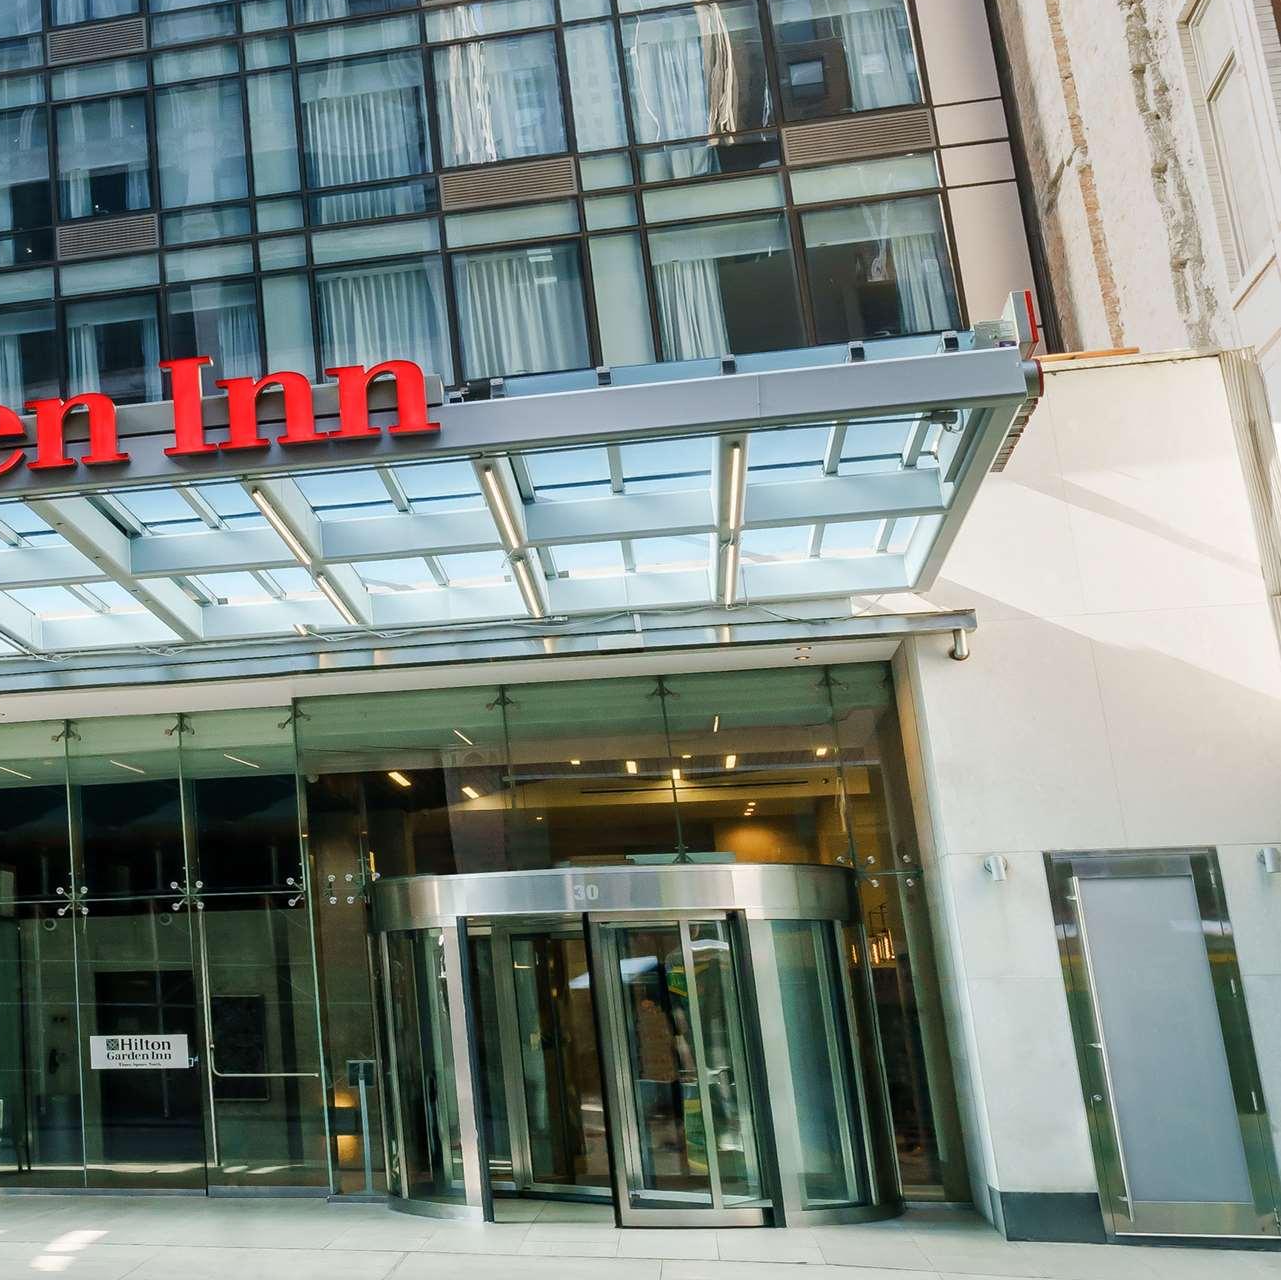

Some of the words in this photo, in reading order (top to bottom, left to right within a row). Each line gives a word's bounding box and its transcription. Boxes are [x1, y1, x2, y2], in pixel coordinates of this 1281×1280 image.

[158, 355, 442, 458] Inn
[574, 884, 599, 900] 30
[120, 1038, 171, 1051] Hilton
[106, 1051, 149, 1060] Garden
[151, 1051, 172, 1060] Inn
